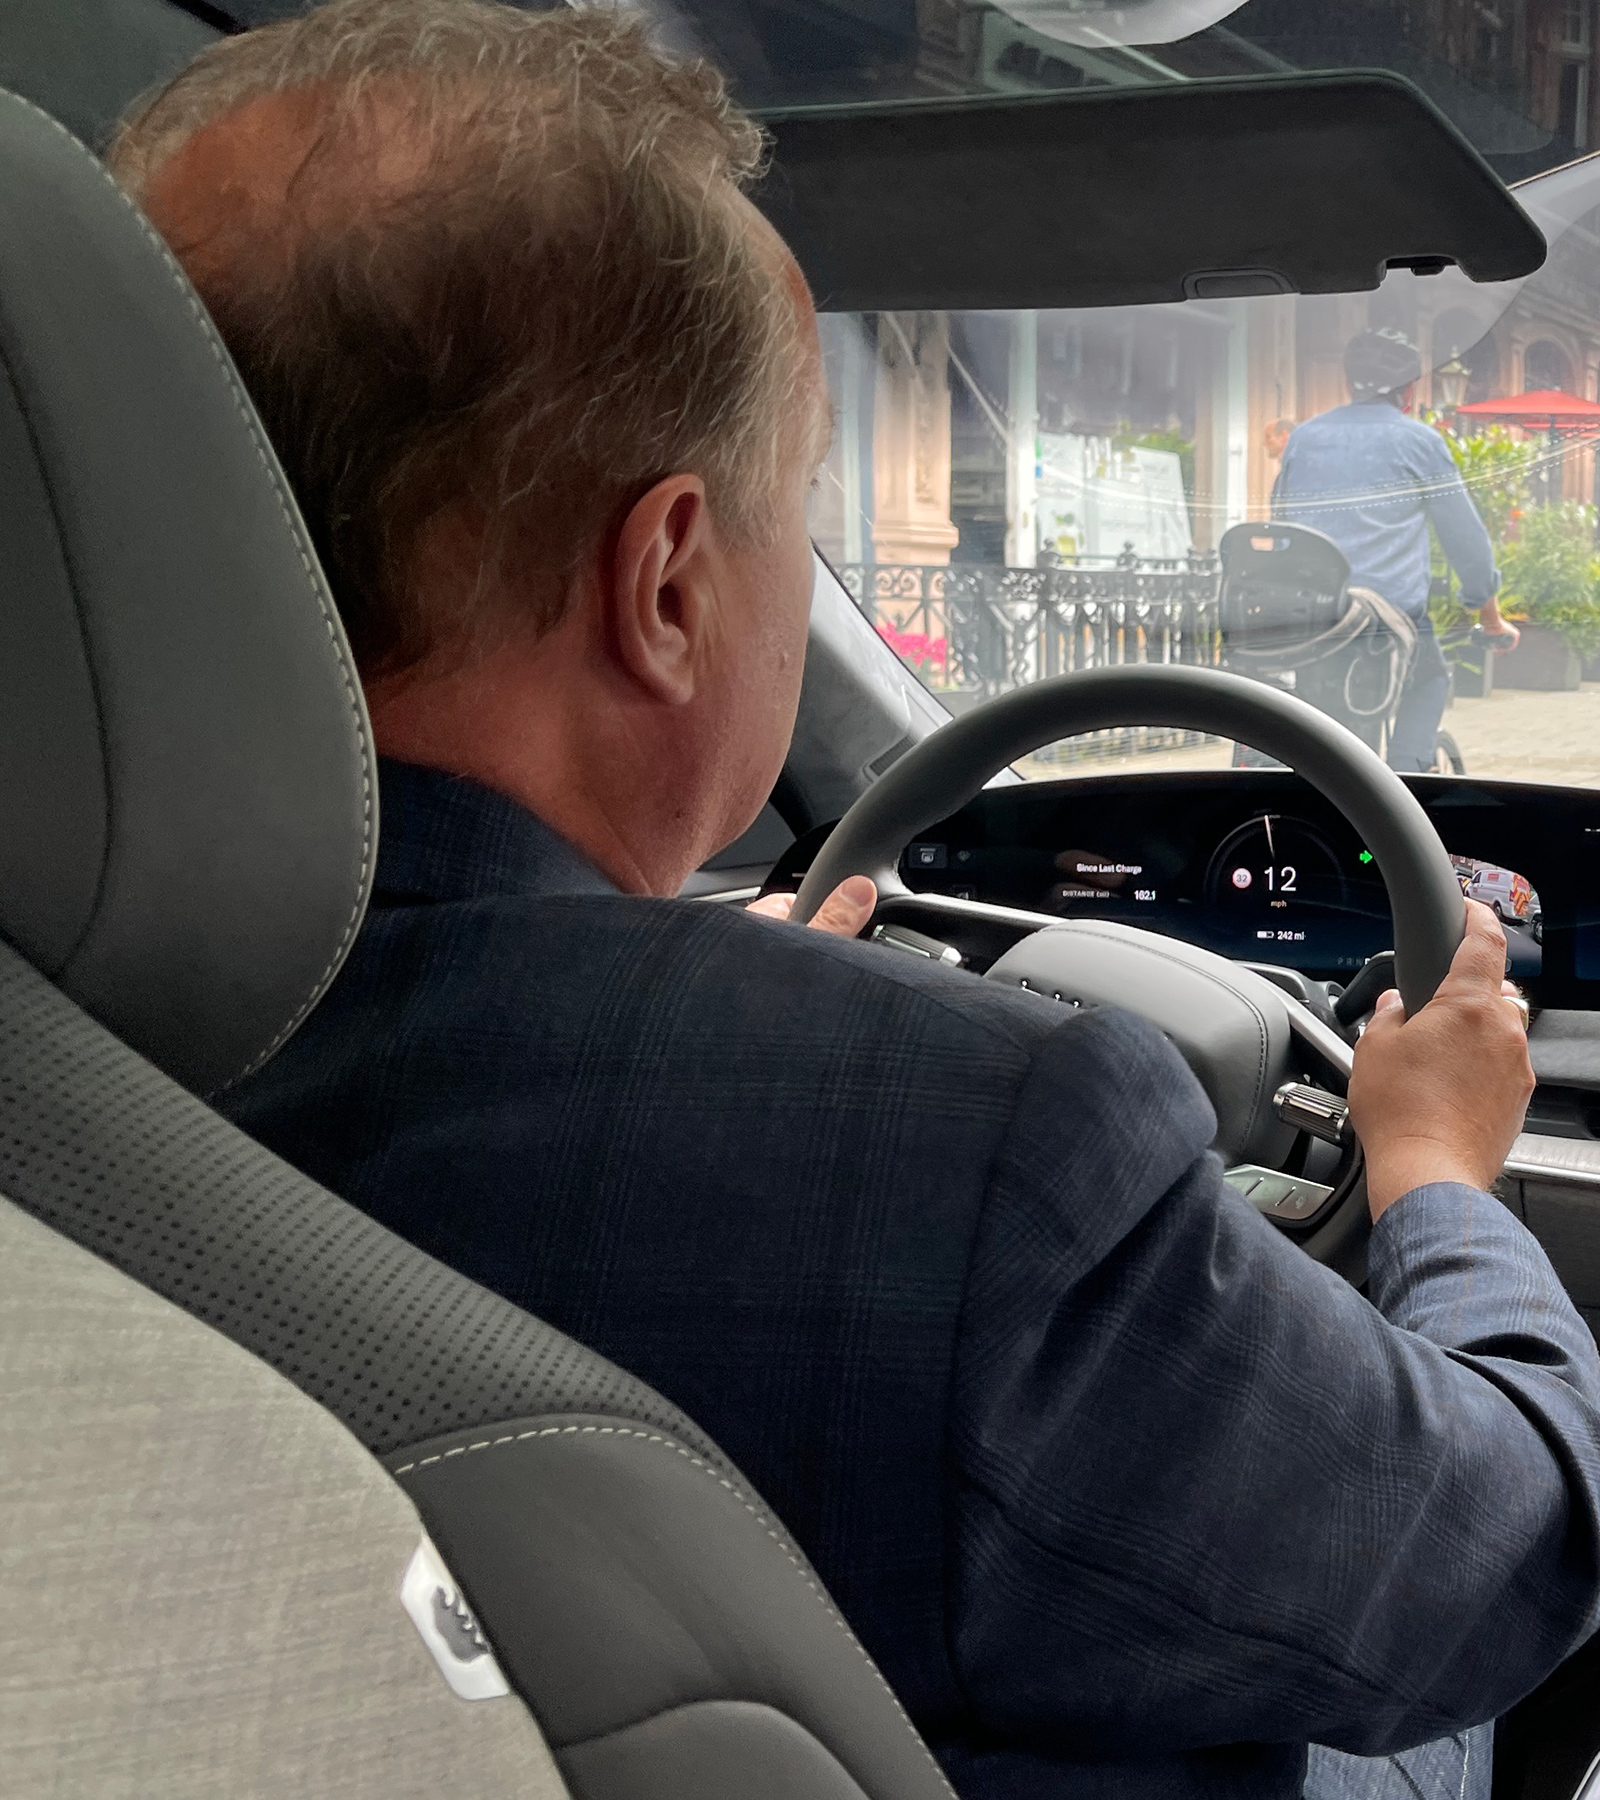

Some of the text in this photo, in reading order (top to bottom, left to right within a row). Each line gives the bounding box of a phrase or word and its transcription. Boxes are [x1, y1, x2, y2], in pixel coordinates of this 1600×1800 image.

[1076, 862, 1143, 875] Since Last Charge
[1235, 865, 1297, 892] 32 12
[1062, 889, 1095, 898] DISTANCE
[1133, 889, 1156, 901] 162.1
[1269, 899, 1287, 909] mph
[1276, 930, 1305, 941] 242 mi
